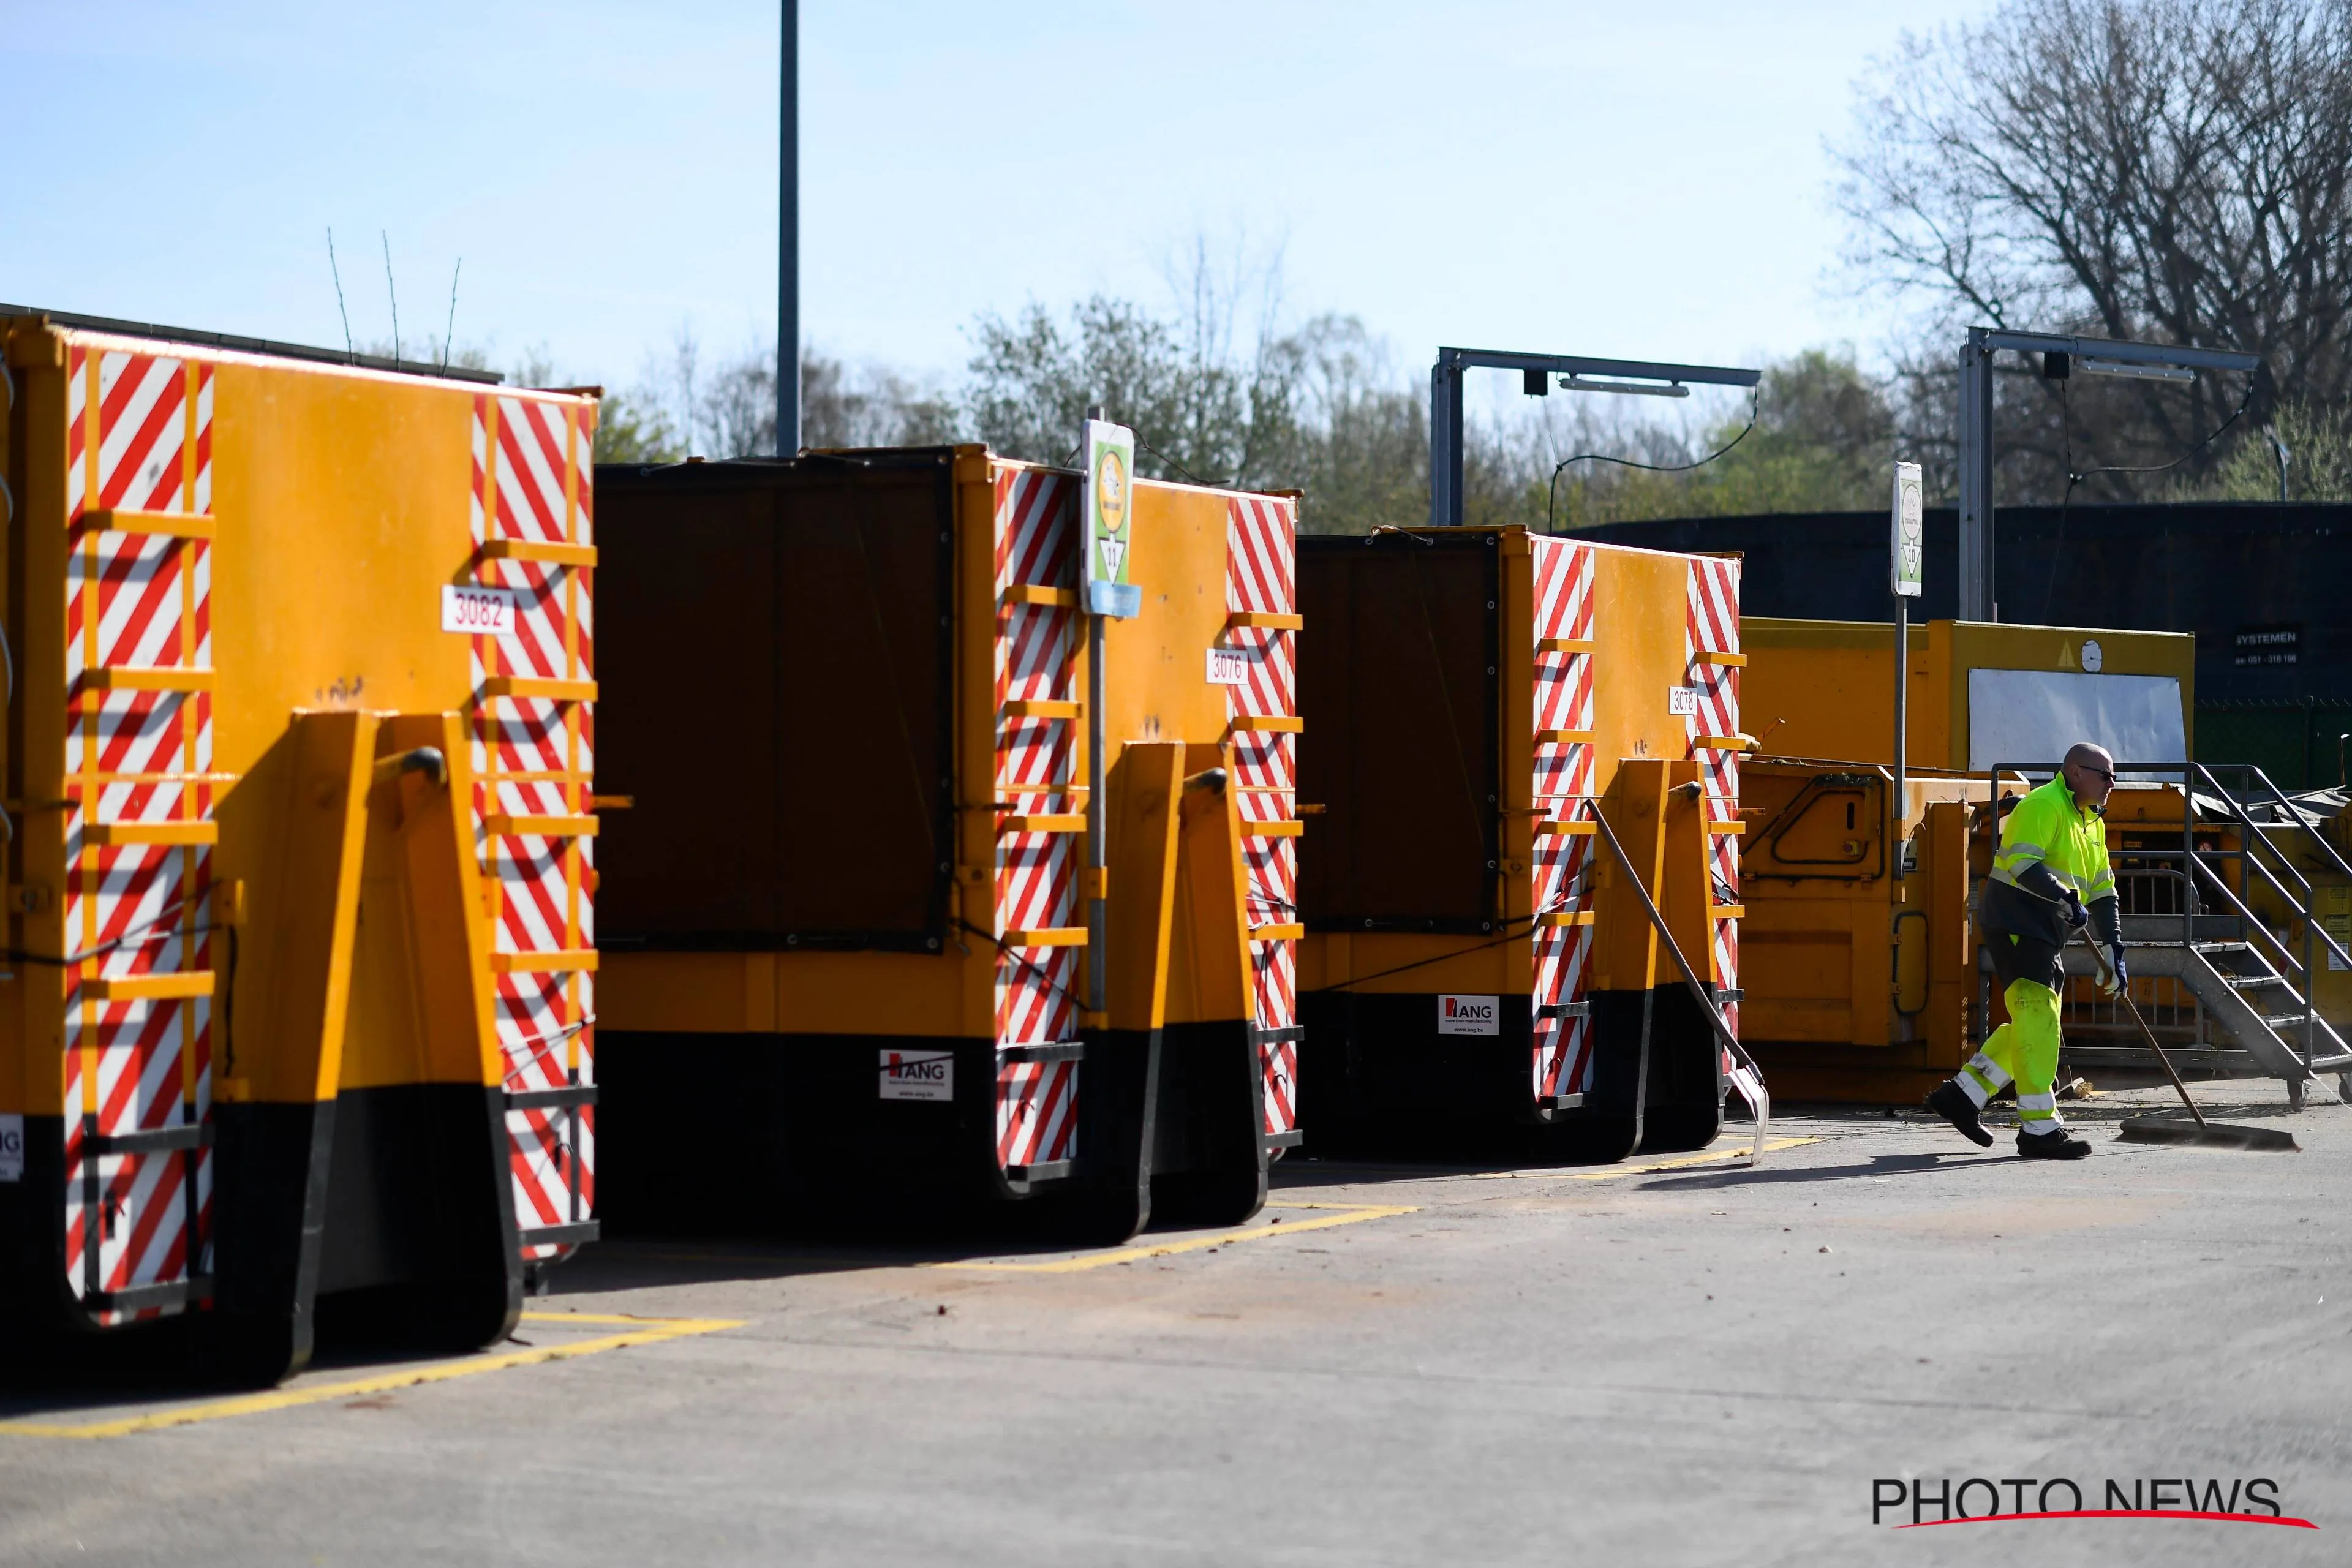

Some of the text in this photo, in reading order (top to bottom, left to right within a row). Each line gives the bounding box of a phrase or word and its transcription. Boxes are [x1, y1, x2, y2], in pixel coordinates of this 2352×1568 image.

[1908, 548, 1915, 563] 10
[456, 592, 502, 626] 3082
[1214, 653, 1241, 679] 3076
[1675, 690, 1693, 710] 3078
